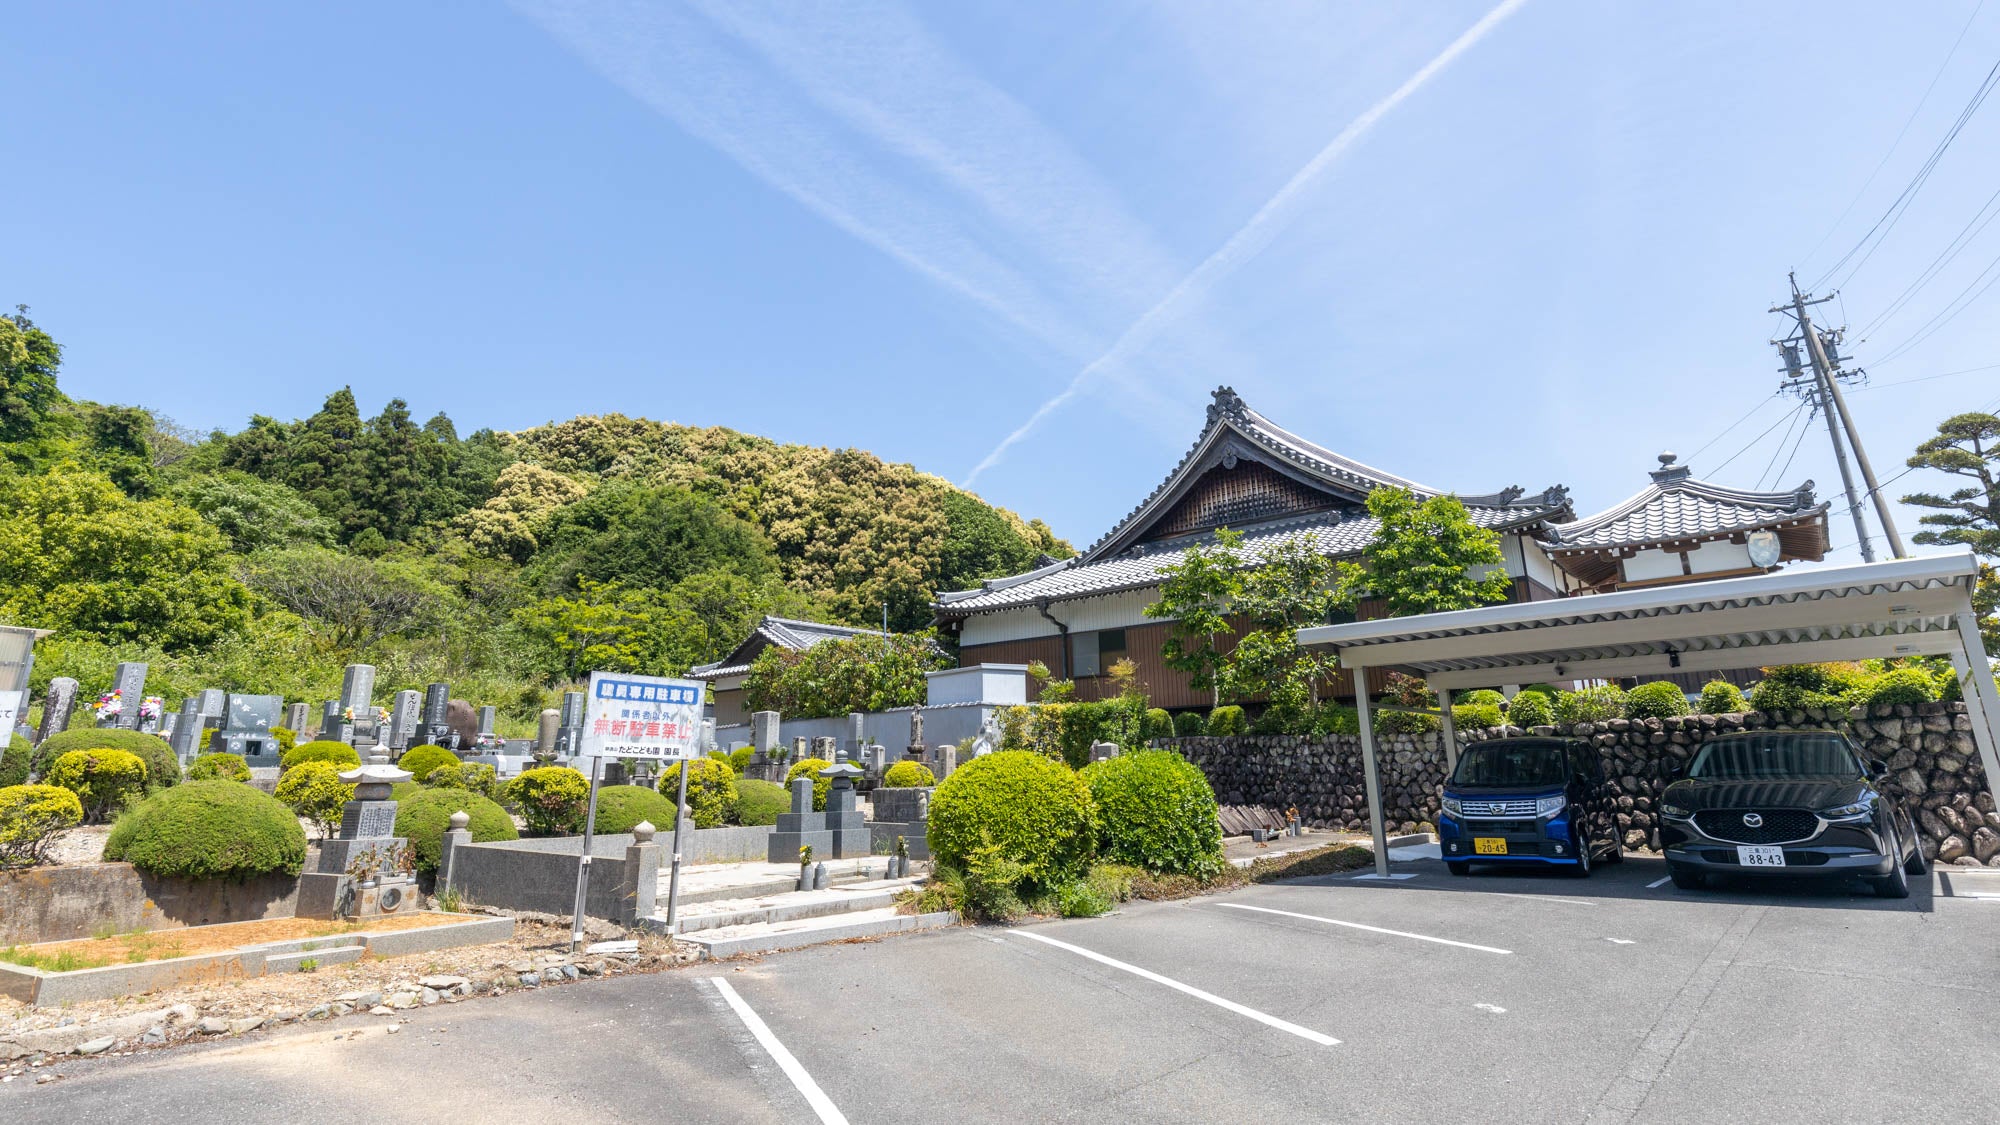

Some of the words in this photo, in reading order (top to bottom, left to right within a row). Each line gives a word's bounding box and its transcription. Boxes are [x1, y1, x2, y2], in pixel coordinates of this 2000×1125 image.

[601, 683, 694, 702] 職員専用駐車場
[621, 709, 670, 720] 関係者以外
[594, 719, 693, 740] 無断駐車禁止
[619, 746, 660, 755] たどこども園
[664, 747, 680, 756] 園長
[1749, 855, 1782, 864] 88-43
